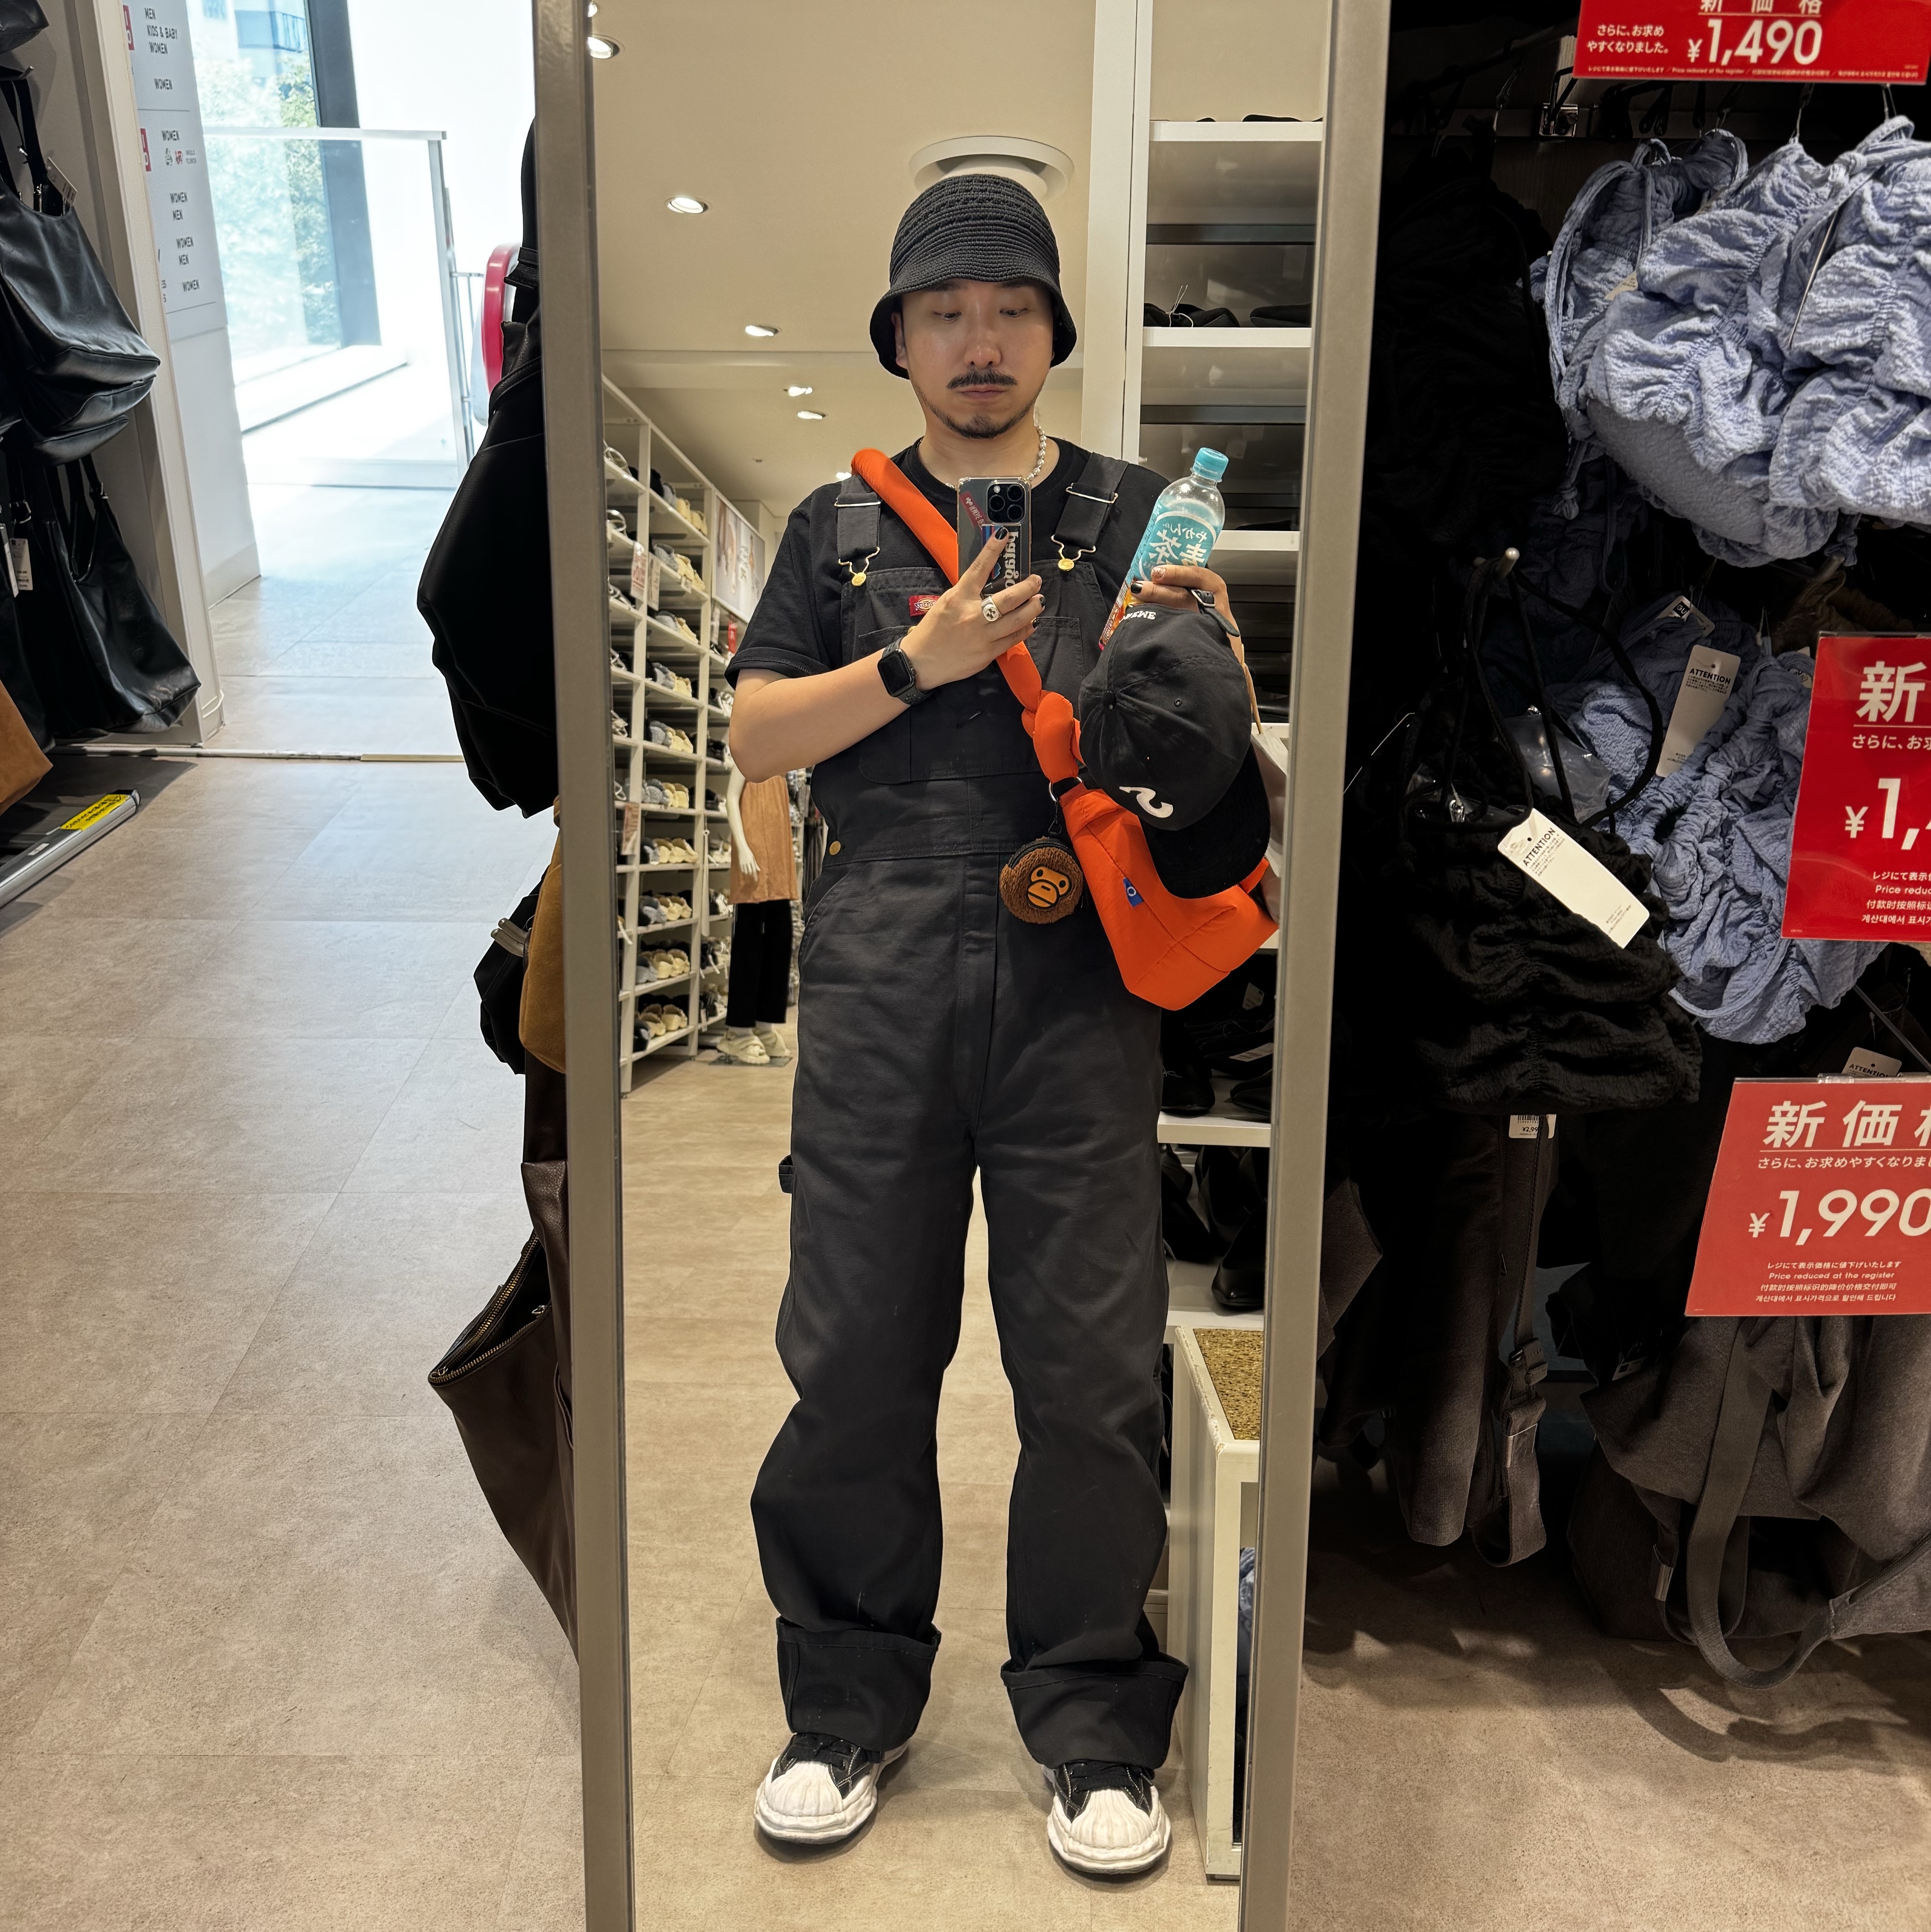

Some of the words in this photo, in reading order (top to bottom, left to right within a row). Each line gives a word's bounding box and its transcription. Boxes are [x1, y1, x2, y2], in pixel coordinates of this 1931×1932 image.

[145, 8, 156, 19] MEN
[147, 25, 158, 37] KIDS
[159, 27, 164, 37] &
[165, 28, 178, 39] BABY
[1597, 24, 1665, 37] さらに、お求め
[149, 42, 168, 54] WOMEN
[1587, 41, 1669, 54] やすくなりました。
[1688, 19, 1822, 66] ¥1,490
[154, 78, 173, 90] WOMEN
[161, 130, 180, 141] WOMEN
[170, 192, 188, 203] WOMEN
[173, 210, 183, 220] MEN
[176, 237, 194, 248] WOMEN
[179, 254, 189, 265] MEN
[182, 280, 200, 292] WOMEN
[1677, 605, 1687, 614] GU
[1690, 668, 1731, 684] ATTENTION
[1844, 778, 1931, 850] ¥1,
[1523, 827, 1556, 867] ATTENTION
[1875, 885, 1901, 894] Price
[1862, 914, 1905, 925] 계산대에서
[1748, 1189, 1931, 1246] ¥1,990
[1767, 1261, 1901, 1269] レジにて表示価格に値下げいたします
